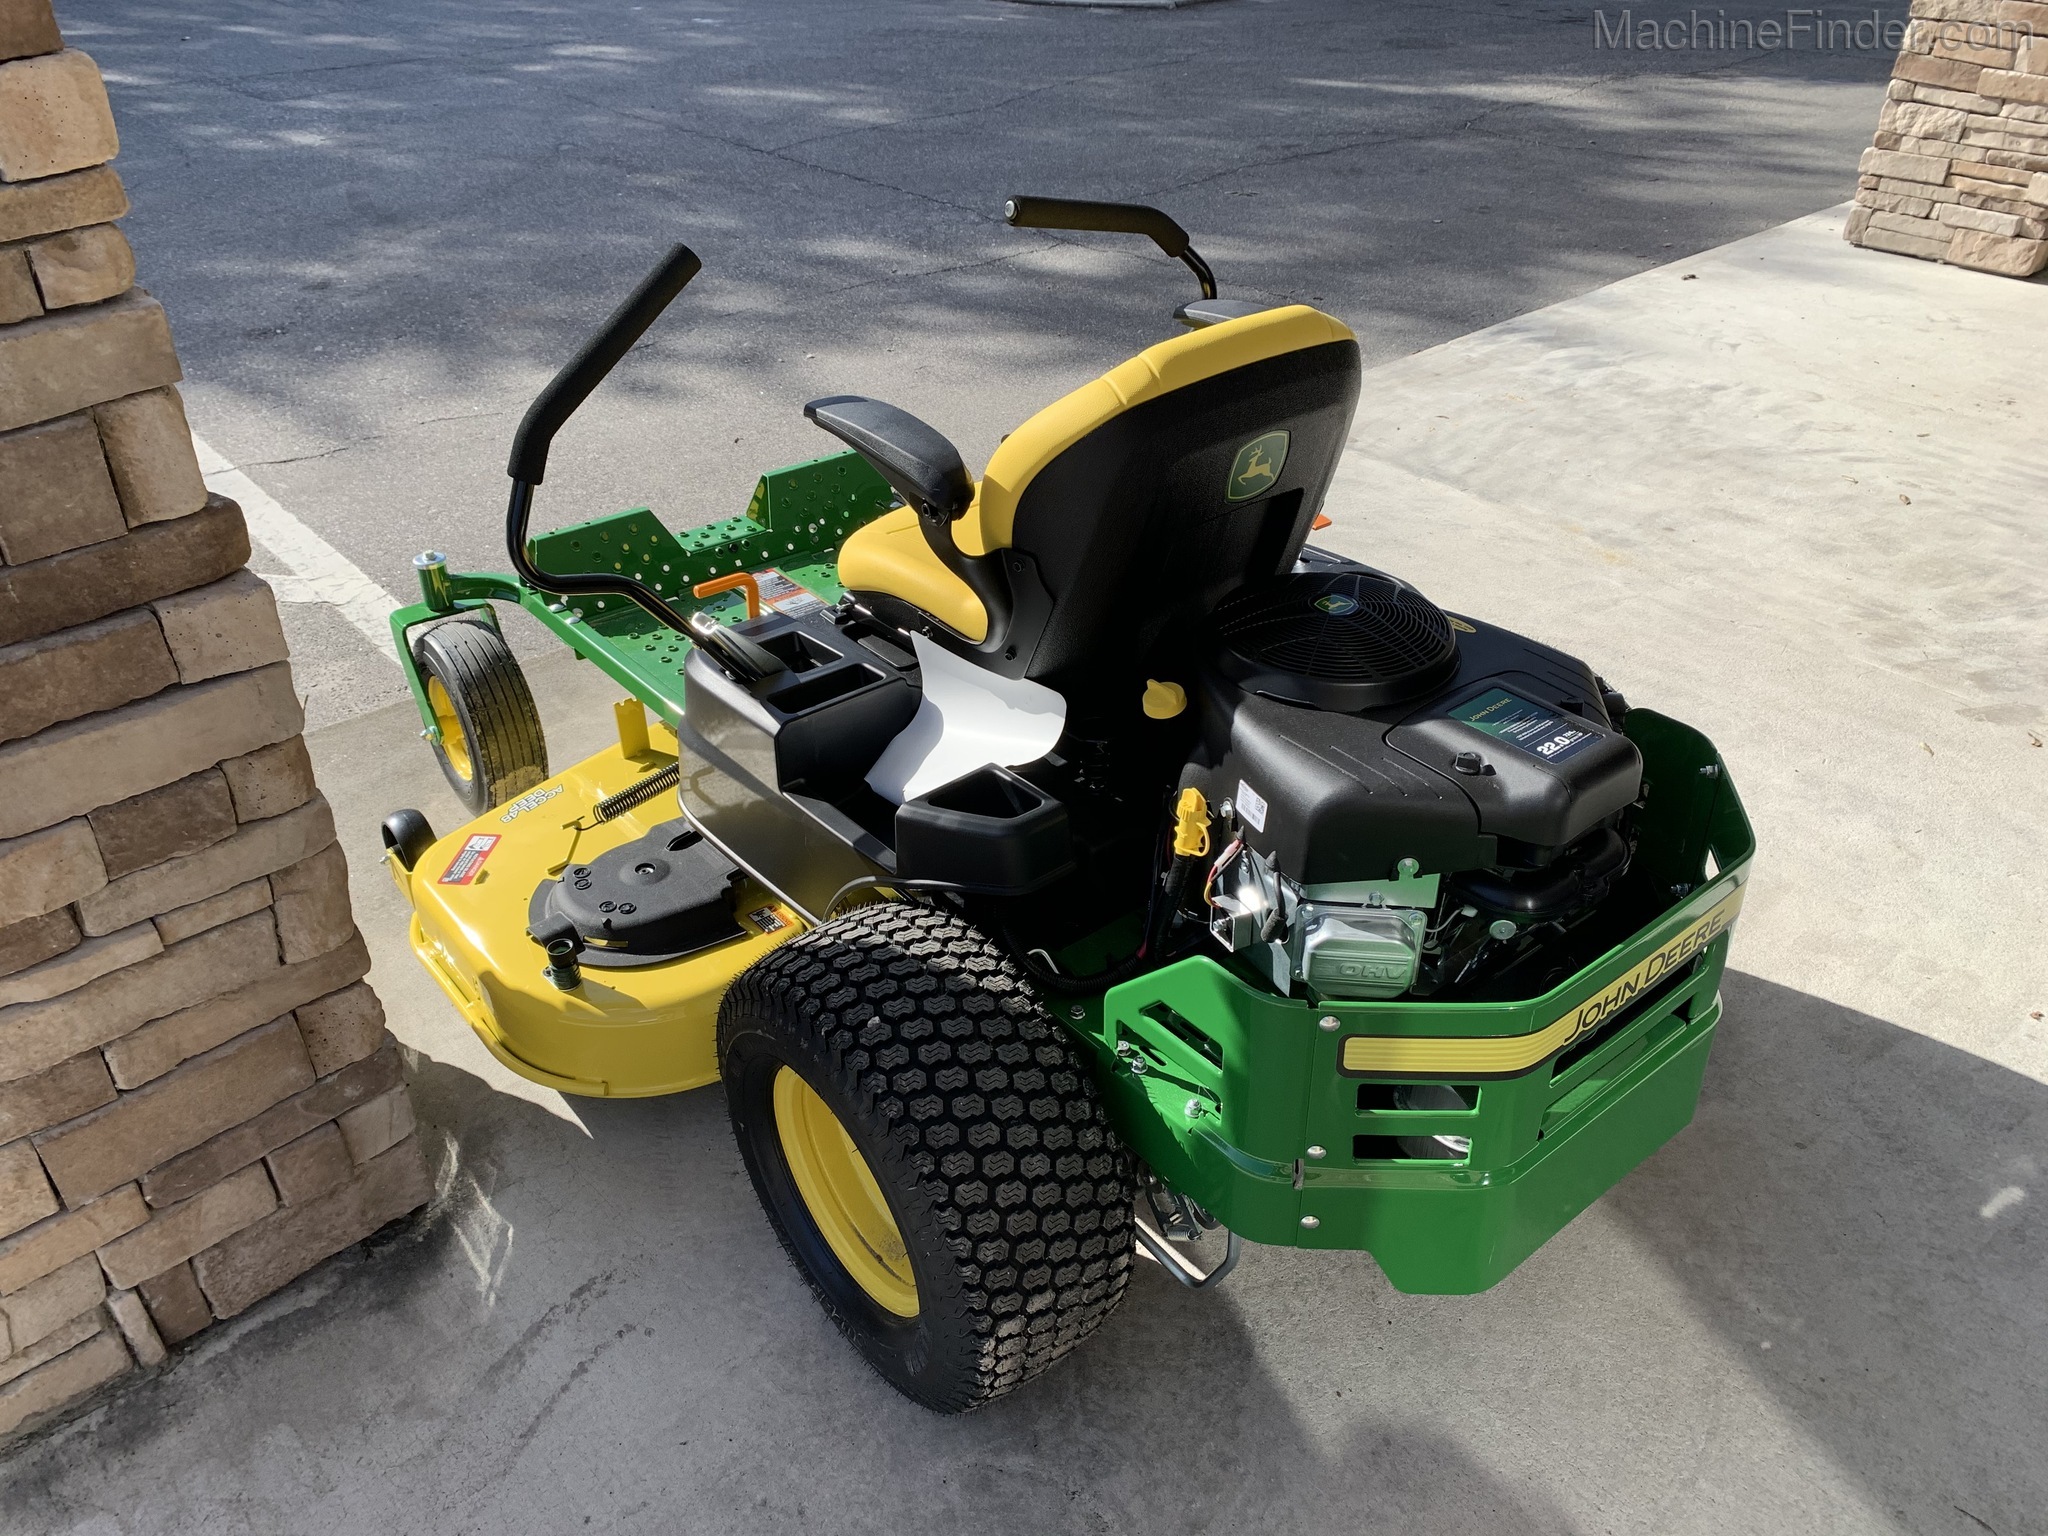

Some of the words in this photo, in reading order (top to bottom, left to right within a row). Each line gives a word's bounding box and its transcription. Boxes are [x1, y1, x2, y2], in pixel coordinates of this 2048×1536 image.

[1469, 709, 1490, 721] JOHN
[1487, 698, 1512, 712] DEERE
[1537, 736, 1571, 755] 22.0
[508, 788, 547, 812] DEEP
[1340, 963, 1407, 979] OHV
[1563, 973, 1641, 1043] JOHN
[1644, 909, 1726, 983] DEERE
